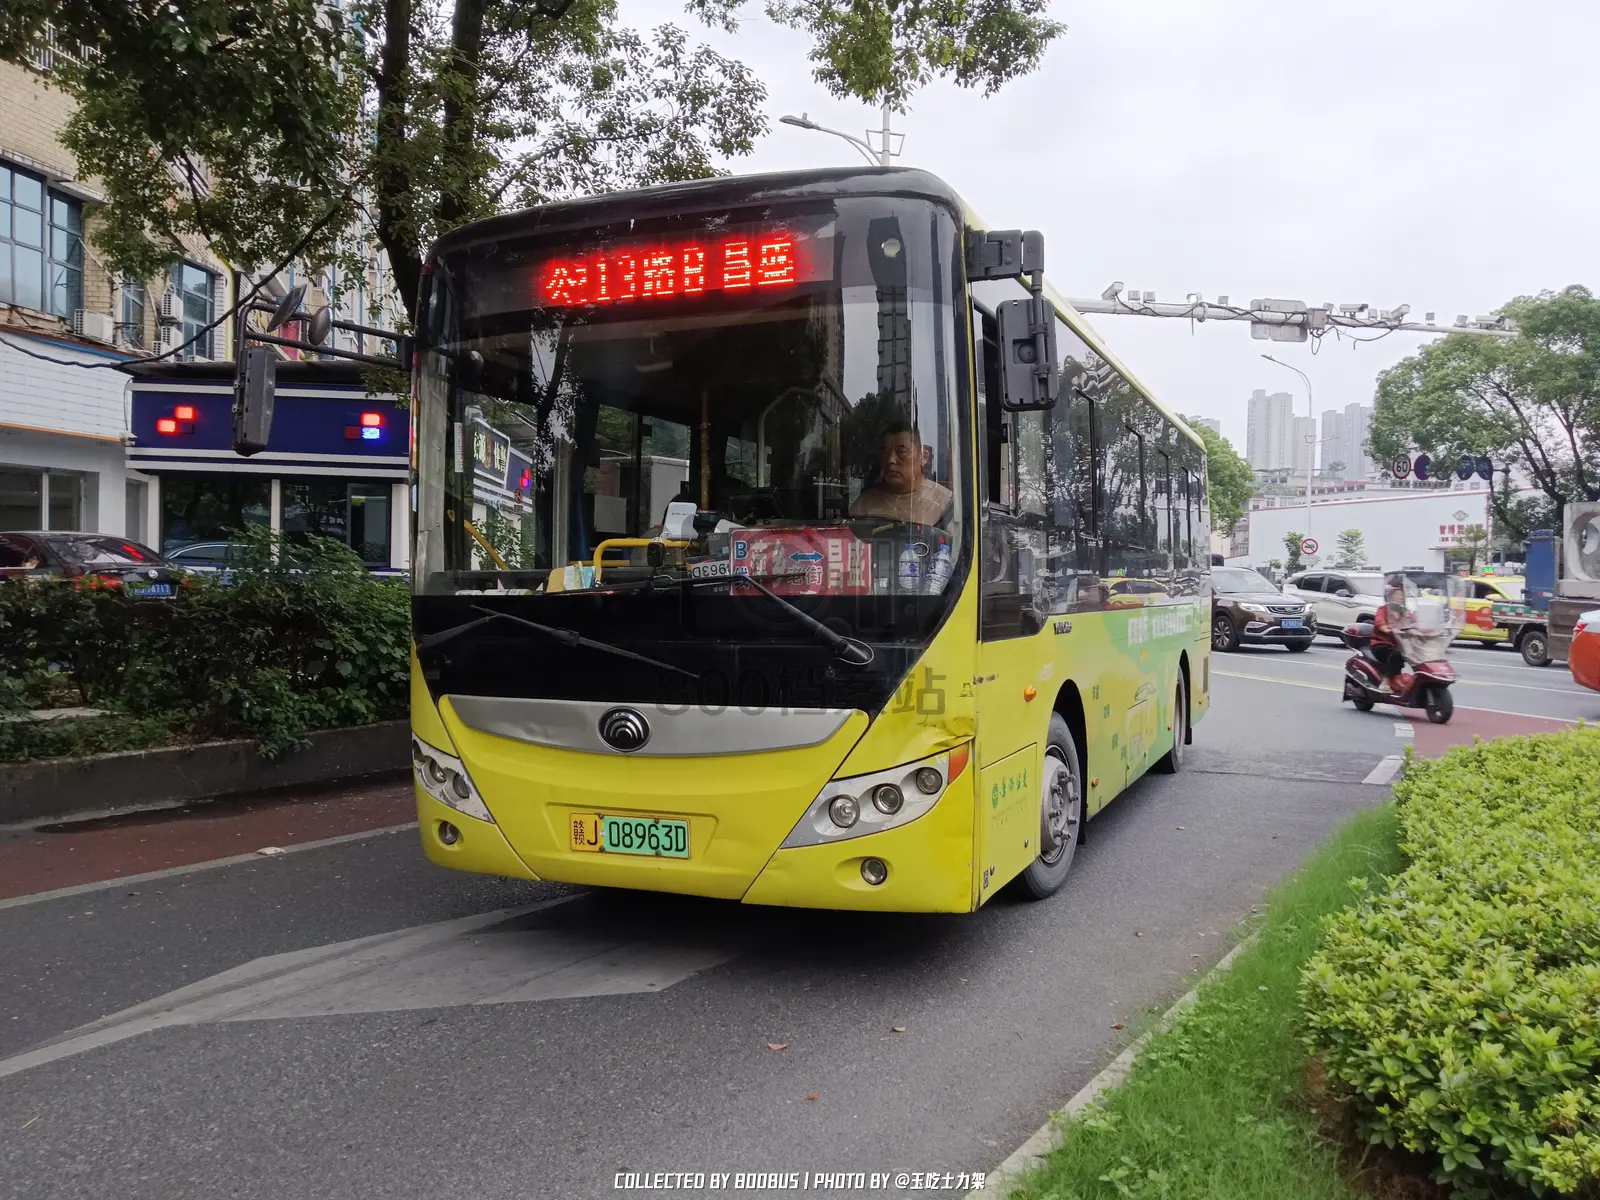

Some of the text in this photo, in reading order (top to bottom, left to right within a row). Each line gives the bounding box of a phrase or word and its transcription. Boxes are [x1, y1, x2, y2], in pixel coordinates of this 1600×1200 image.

[723, 237, 795, 289] 昌盛
[1396, 461, 1408, 473] 60
[827, 537, 866, 589] 昌盛
